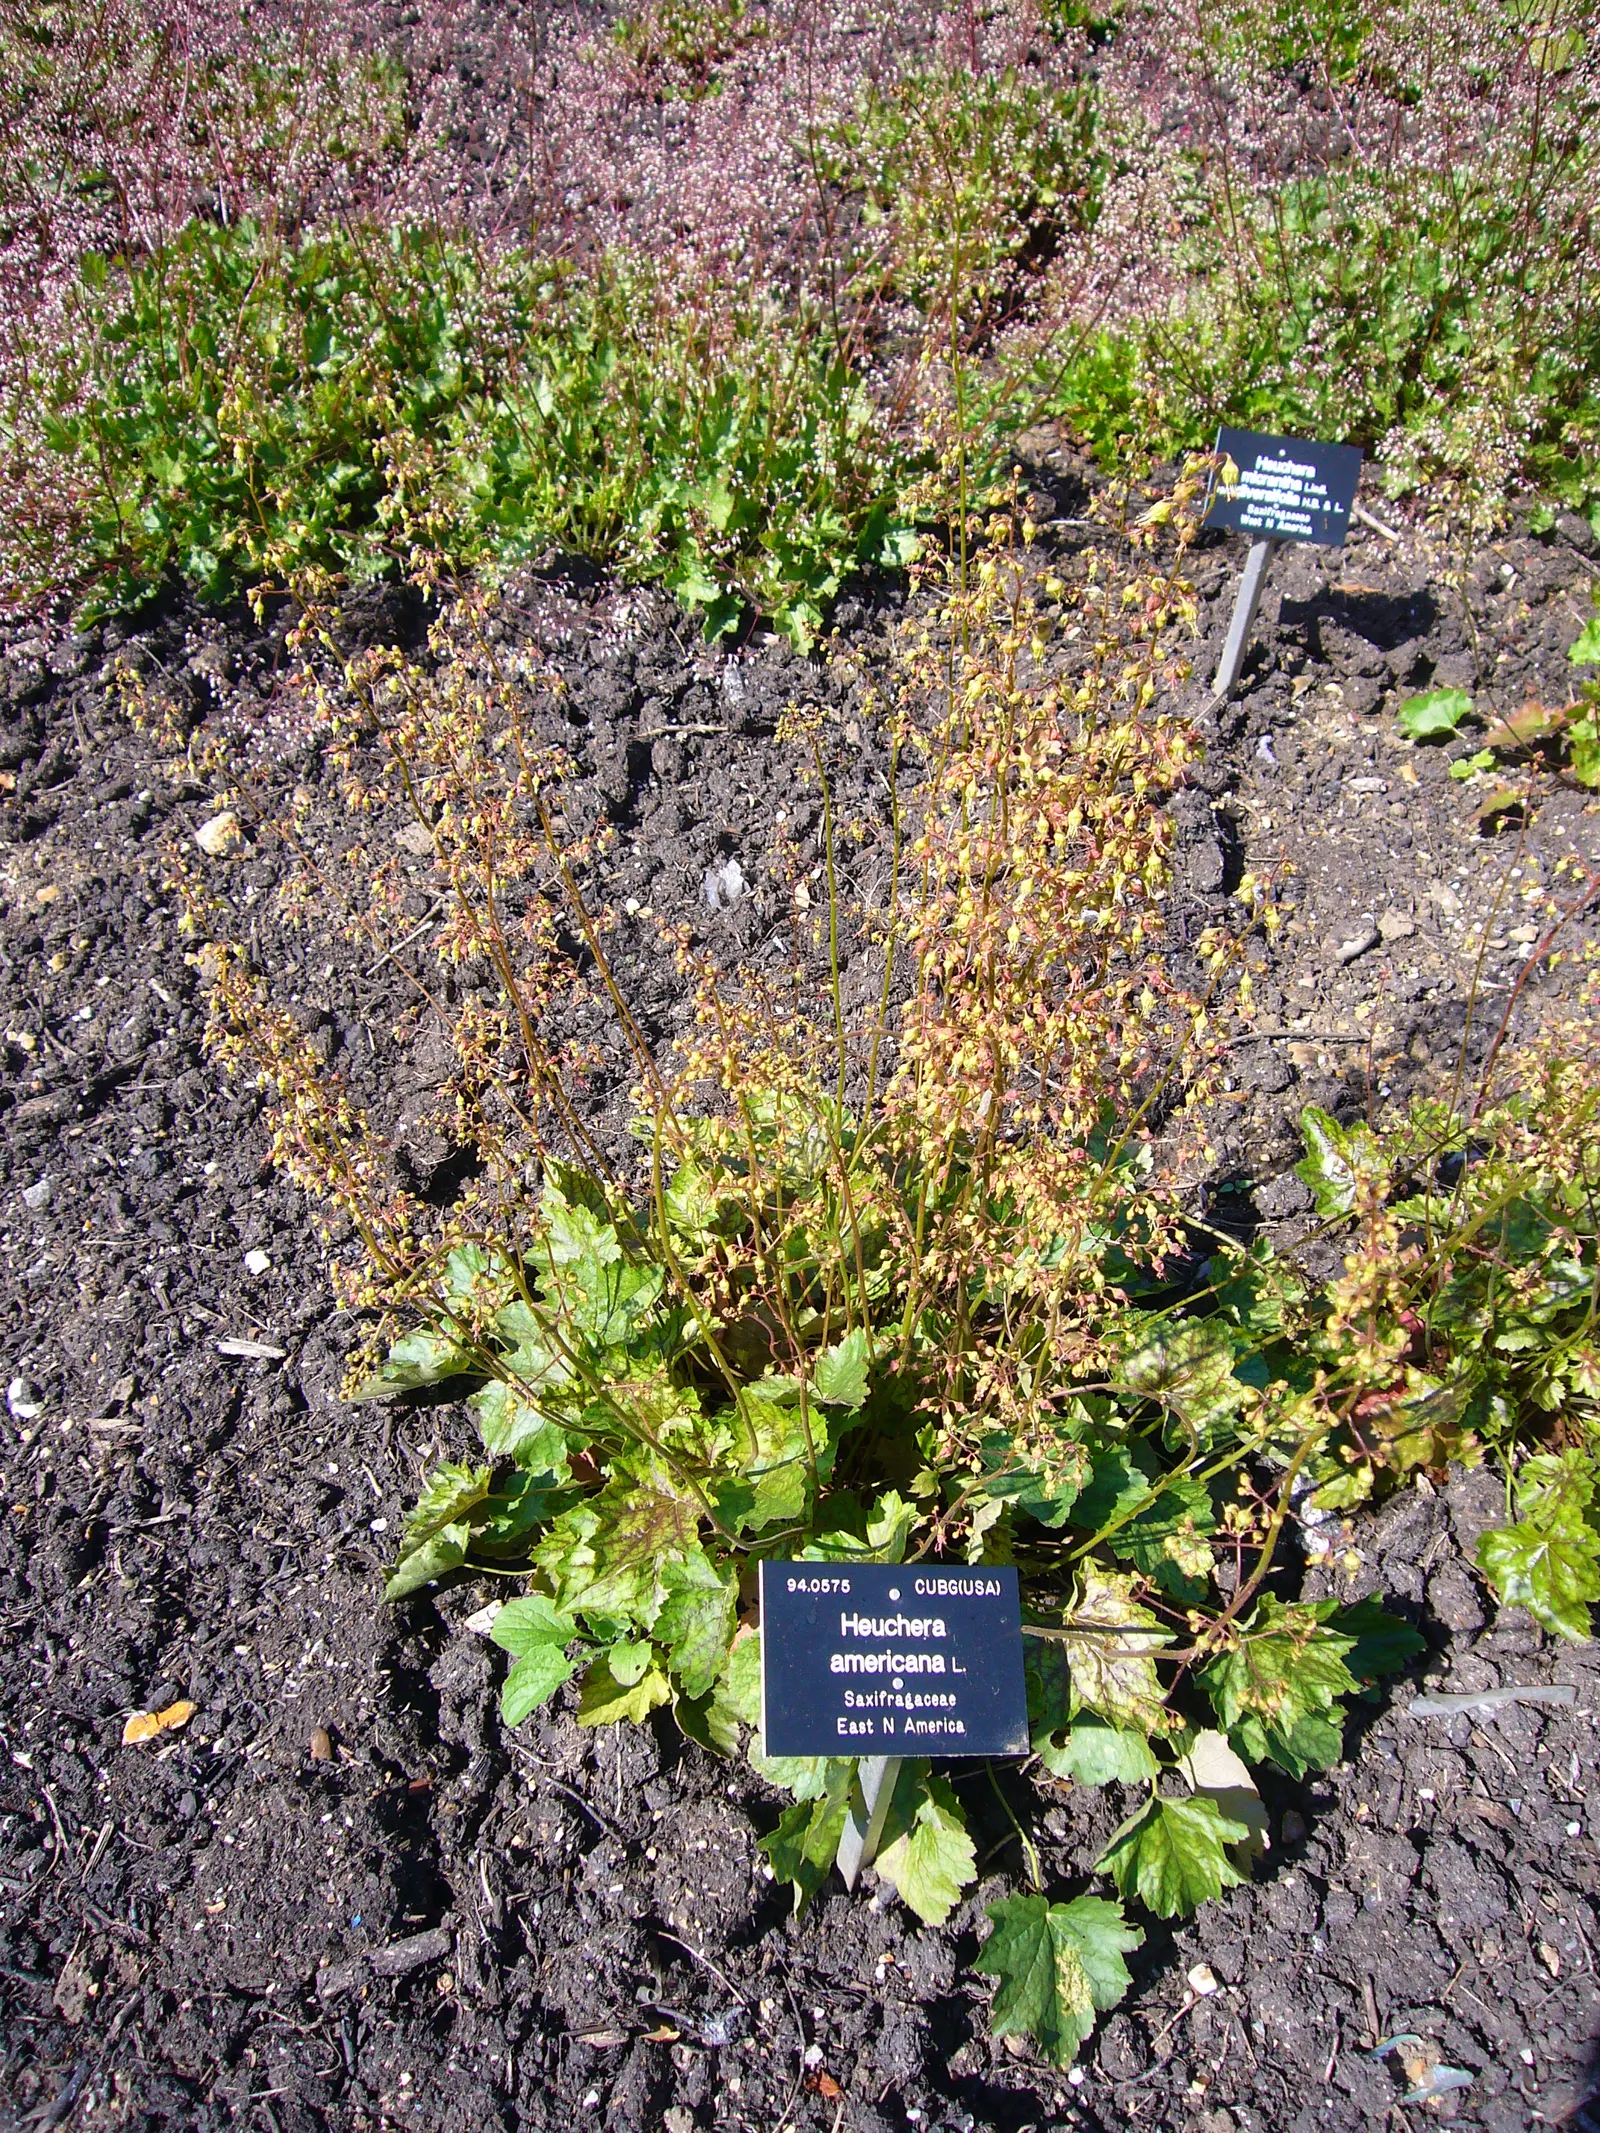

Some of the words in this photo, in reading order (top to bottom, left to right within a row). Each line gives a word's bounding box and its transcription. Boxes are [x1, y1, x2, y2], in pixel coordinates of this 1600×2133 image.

[1255, 455, 1316, 478] Heuchera
[1240, 470, 1303, 491] micrantha
[1246, 503, 1312, 523] Saxifragaceae
[1240, 514, 1263, 527] West
[1265, 517, 1275, 529] N
[1276, 521, 1313, 535] America
[787, 1578, 851, 1594] 94.0575
[914, 1579, 1001, 1596] CUBG(USA)
[840, 1612, 946, 1638] Heuchera
[830, 1649, 946, 1674] americana
[951, 1657, 967, 1673] L.
[844, 1690, 957, 1710] Saxifragaceae
[836, 1717, 874, 1735] East
[883, 1717, 895, 1734] N
[904, 1717, 966, 1734] America
